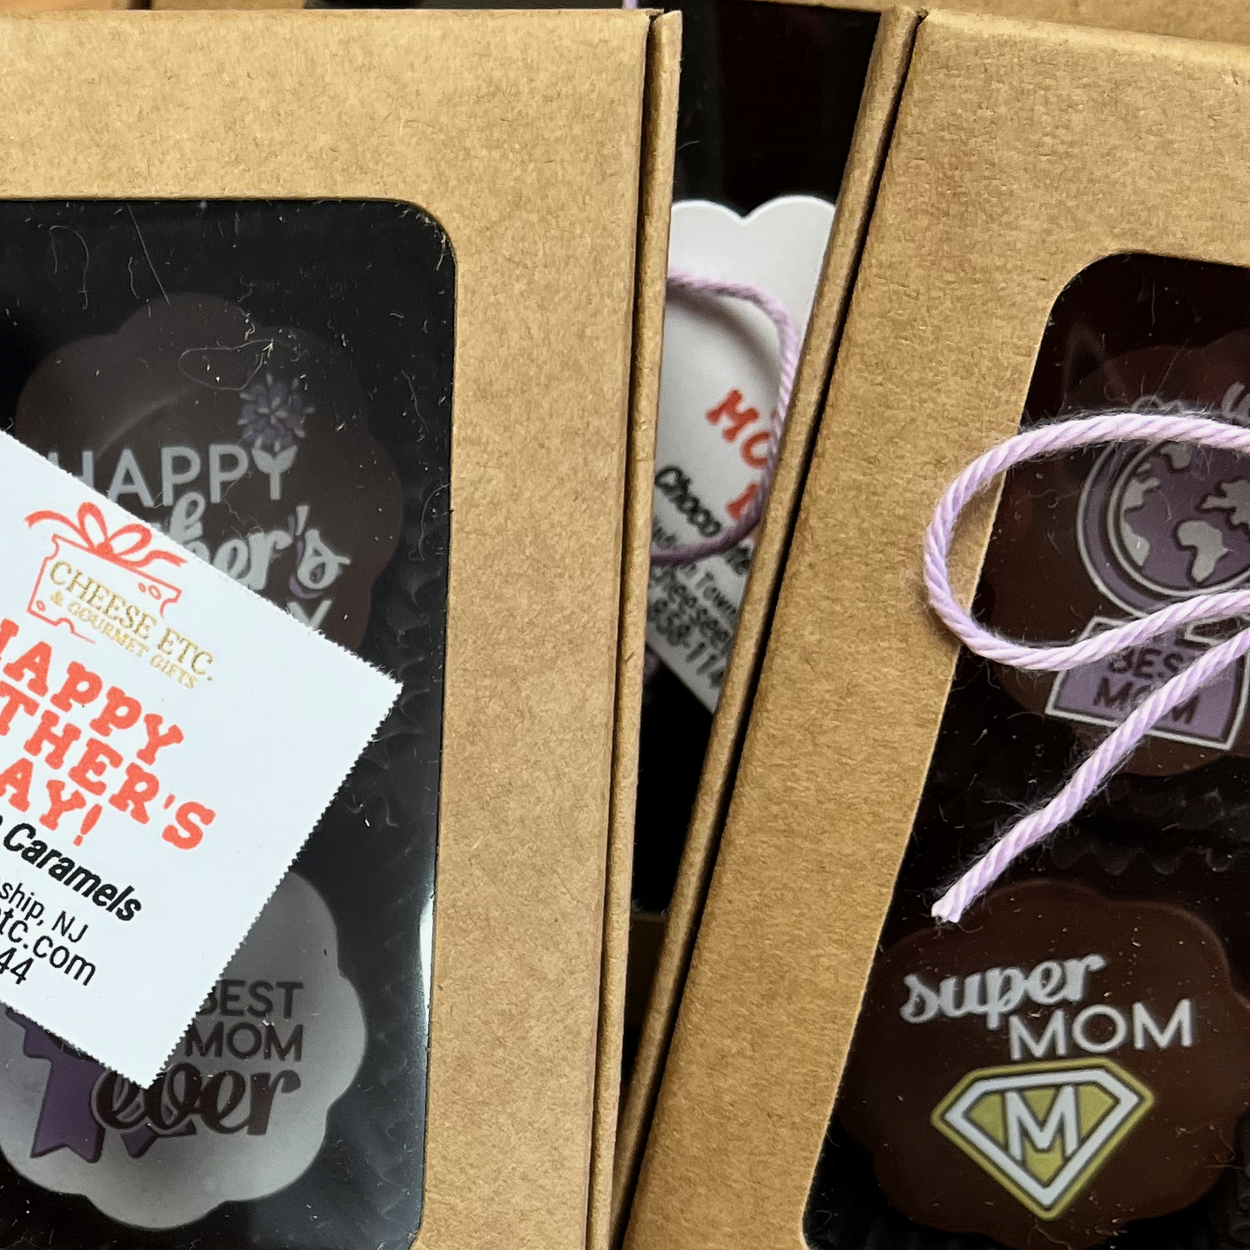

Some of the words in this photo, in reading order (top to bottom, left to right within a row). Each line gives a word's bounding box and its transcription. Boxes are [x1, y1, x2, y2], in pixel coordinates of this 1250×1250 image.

[50, 560, 157, 640] CHEESE
[157, 627, 214, 682] ETC.
[68, 602, 149, 658] GOURMET
[150, 654, 197, 690] GIFTS
[4, 822, 142, 921] Caramels
[51, 911, 88, 943] NJ
[899, 954, 1106, 1030] super
[1010, 999, 1193, 1061] MOM
[96, 1063, 301, 1135] ever
[1005, 1085, 1080, 1161] M
